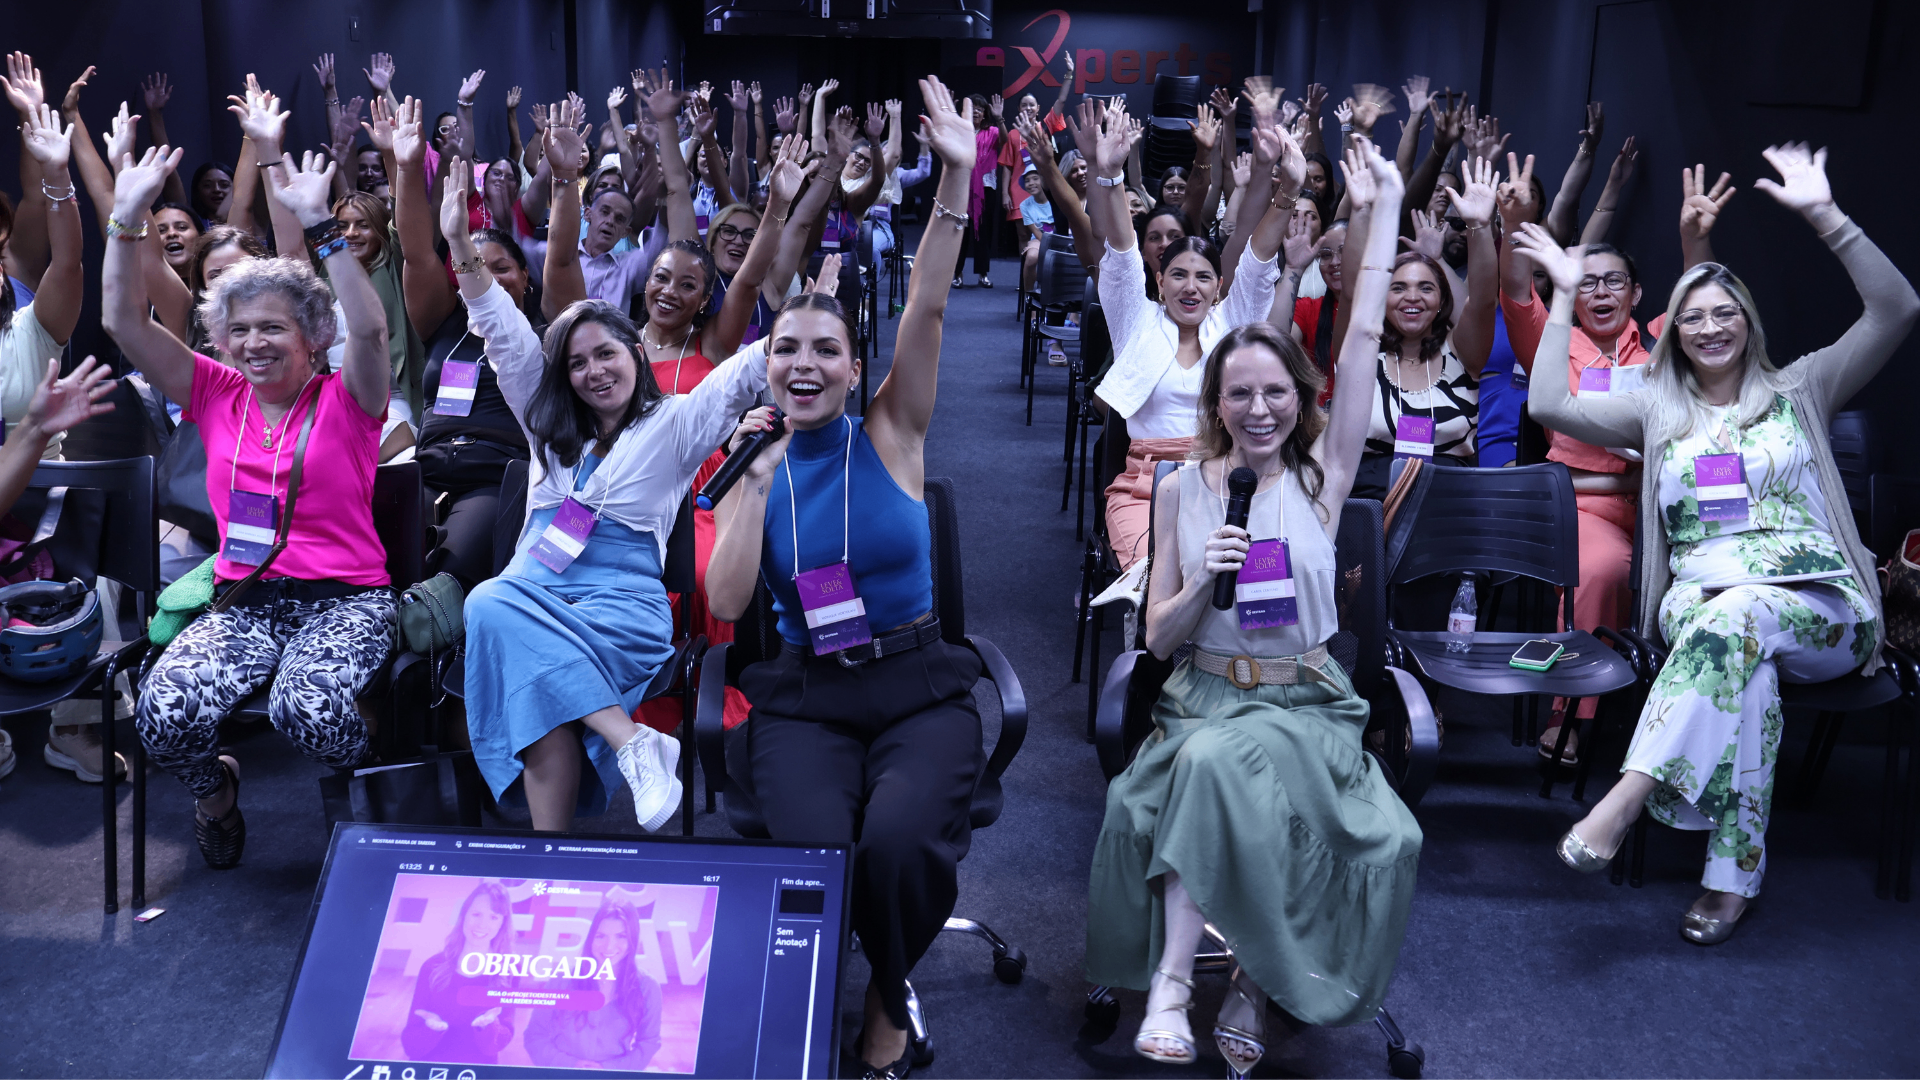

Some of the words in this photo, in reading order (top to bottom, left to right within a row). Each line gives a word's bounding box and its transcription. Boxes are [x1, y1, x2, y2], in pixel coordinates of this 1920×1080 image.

[776, 927, 794, 936] Sem
[775, 938, 808, 948] Anotaçõ
[460, 952, 617, 981] OBRIGADA
